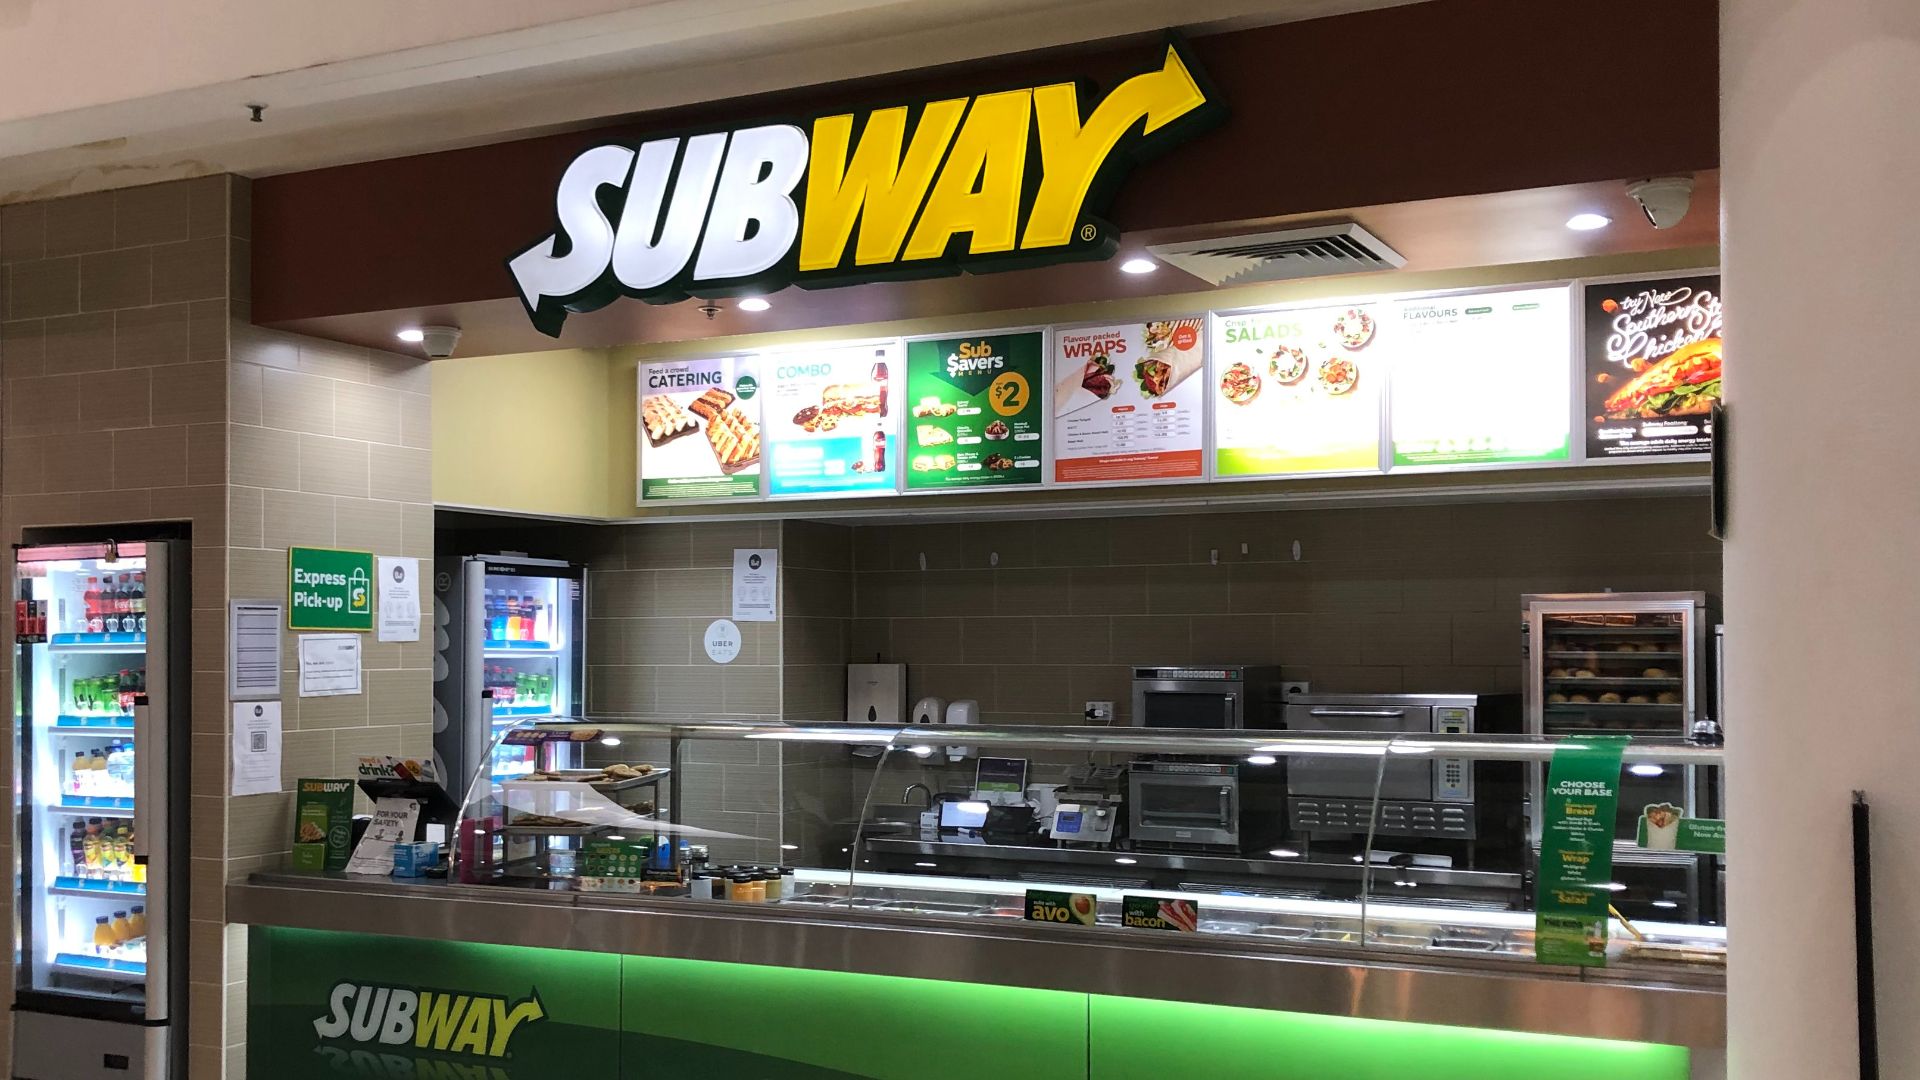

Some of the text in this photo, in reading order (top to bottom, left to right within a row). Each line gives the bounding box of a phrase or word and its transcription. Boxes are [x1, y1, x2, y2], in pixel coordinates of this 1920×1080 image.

[509, 43, 1206, 313] SUBWAY
[1403, 308, 1458, 320] FLAVOURS
[1063, 331, 1120, 343] Flavour packed
[1225, 323, 1303, 343] SALADS
[959, 341, 992, 358] Sub
[1063, 339, 1127, 358] WRAPS
[777, 363, 832, 379] COMBO
[648, 371, 722, 389] CATERING
[294, 568, 347, 587] Express
[294, 590, 343, 612] Pick-up
[358, 762, 395, 777] drink?
[303, 782, 350, 793] SUBWAY
[1552, 788, 1612, 797] YOUR BASE
[1560, 780, 1606, 789] CHOOSE
[376, 810, 409, 819] FOR YOUR
[1566, 807, 1595, 815] Bread
[373, 819, 400, 827] SAFETY
[1562, 854, 1590, 864] Wrap
[1032, 905, 1070, 922] avo
[1125, 912, 1166, 928] bacon
[312, 983, 546, 1058] SUBWAY
